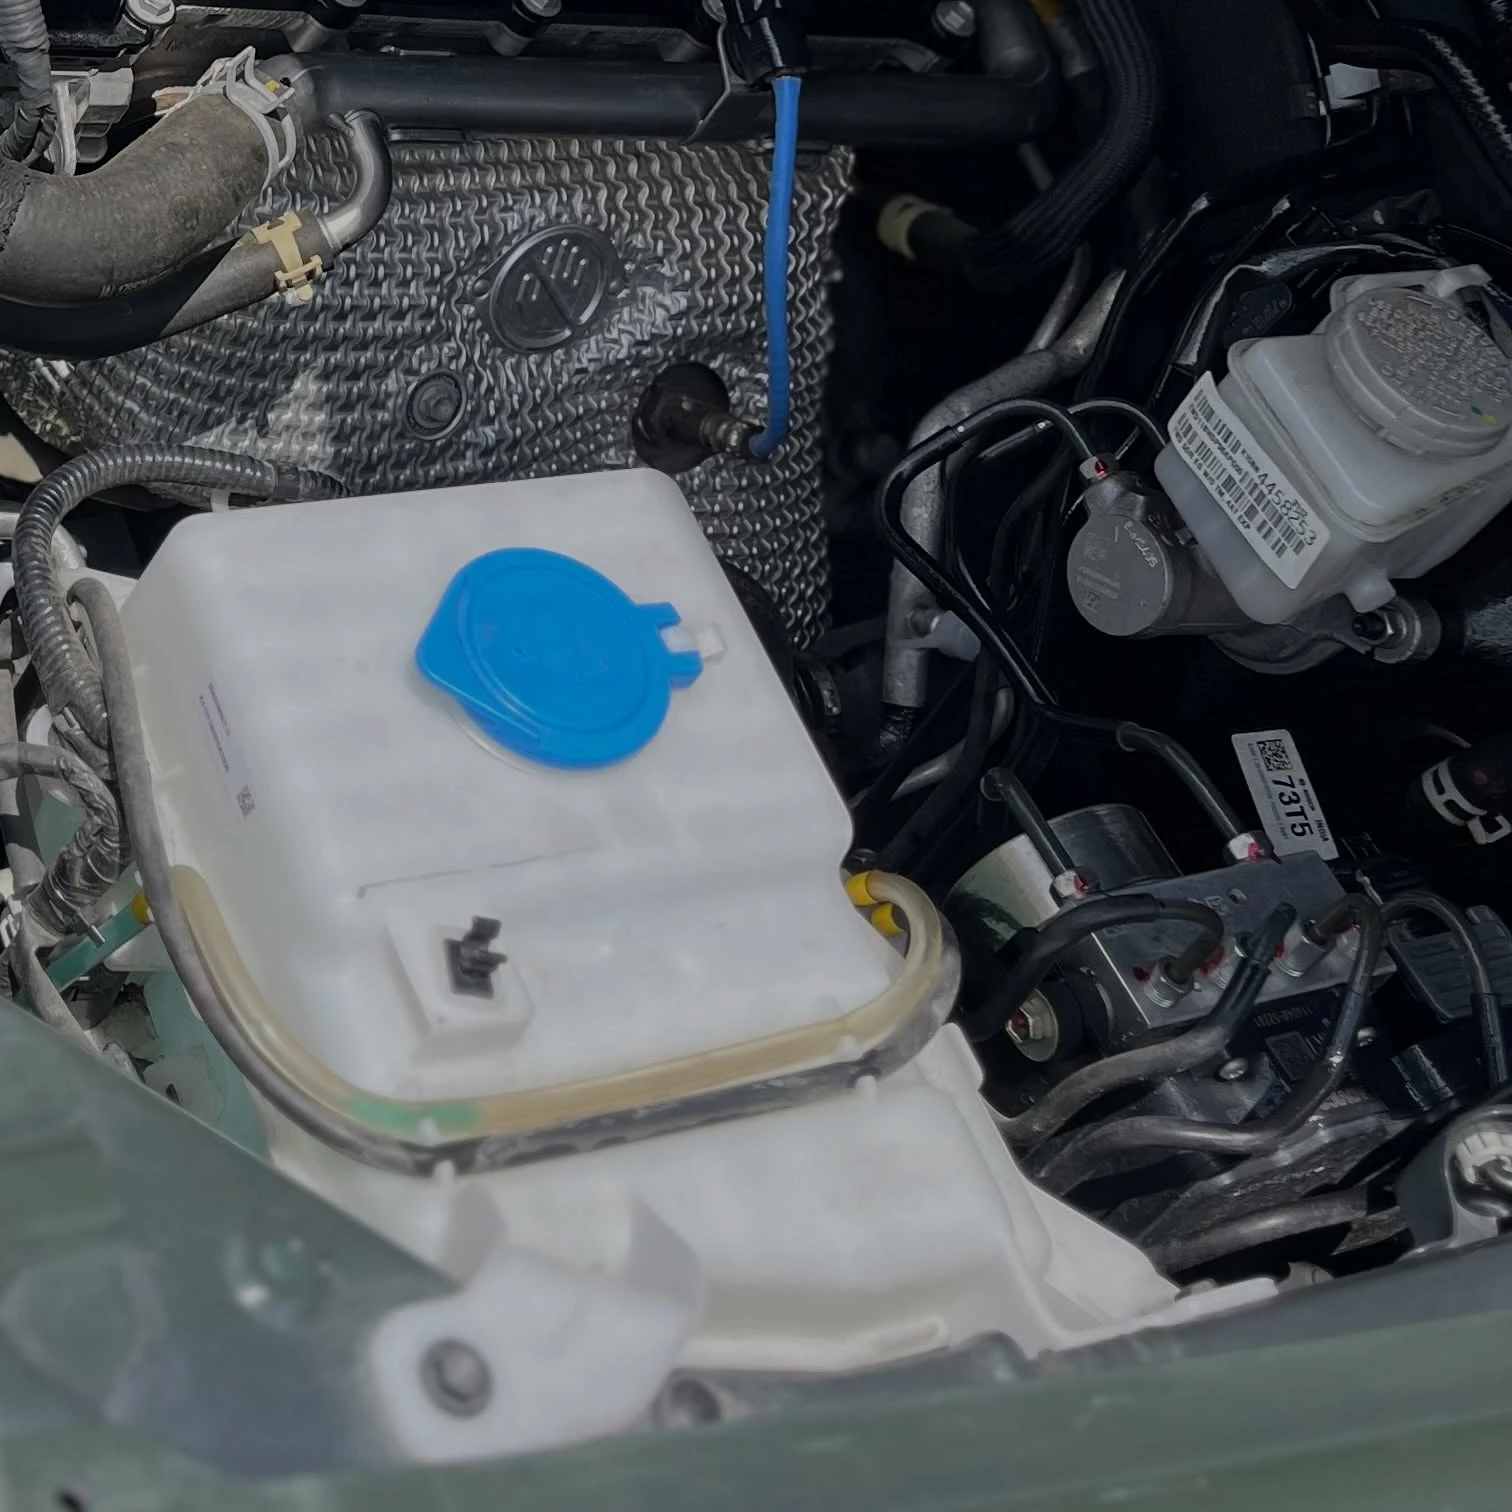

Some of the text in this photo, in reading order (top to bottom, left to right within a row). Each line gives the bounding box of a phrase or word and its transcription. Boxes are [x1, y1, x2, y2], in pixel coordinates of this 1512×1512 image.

[1258, 473, 1317, 546] 4458253
[1272, 775, 1314, 837] 73T5
[1314, 819, 1330, 842] INDIA
